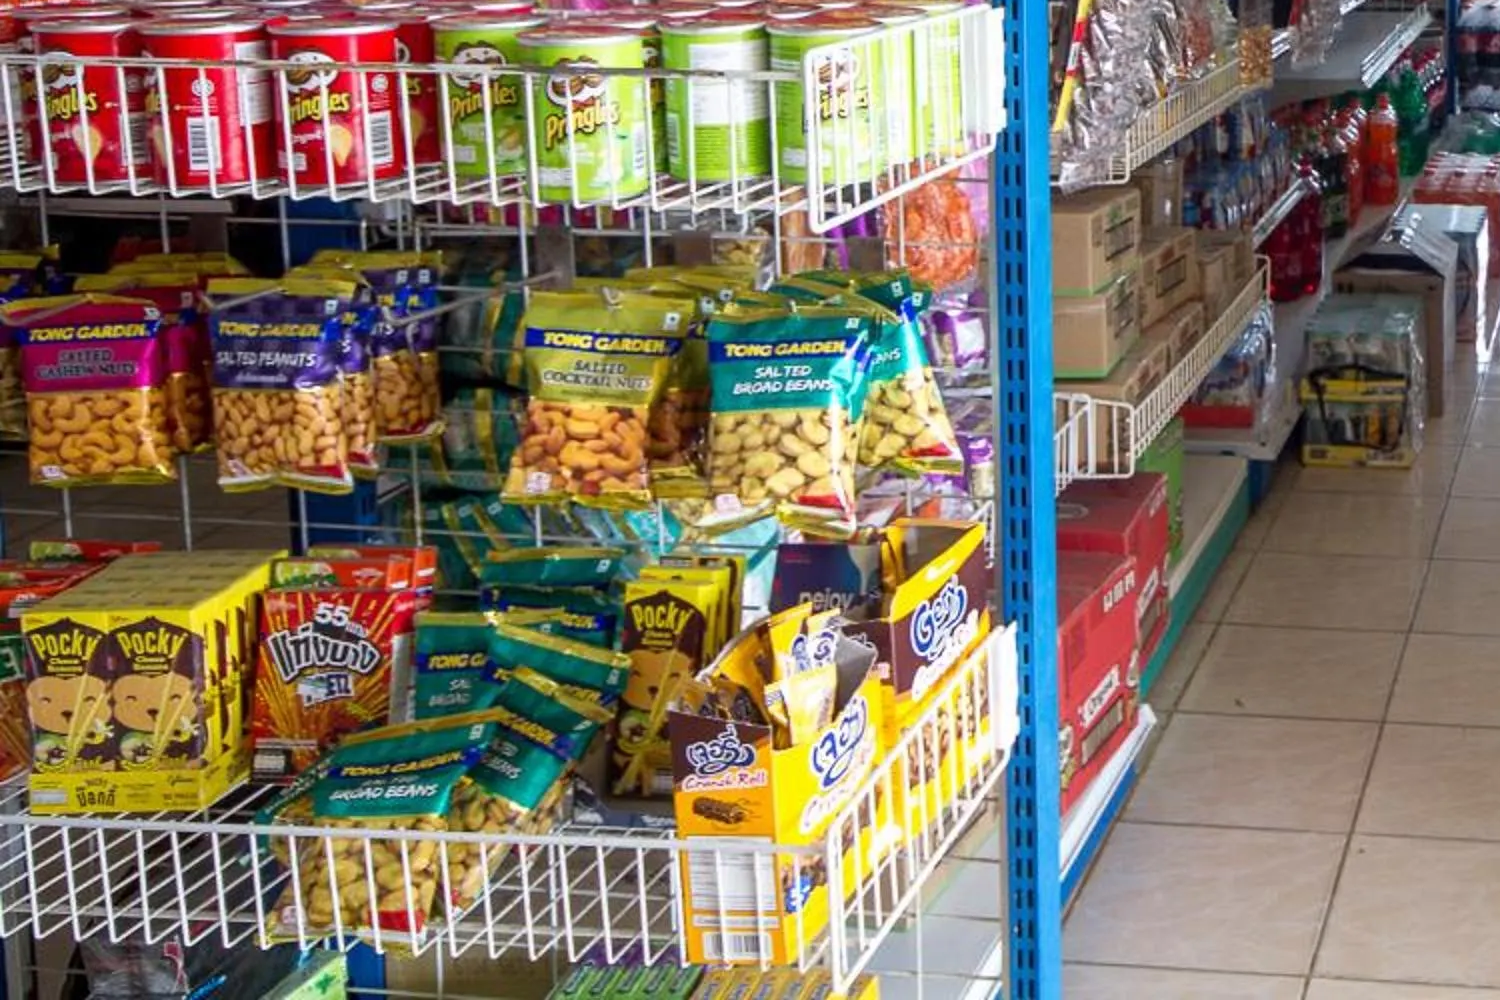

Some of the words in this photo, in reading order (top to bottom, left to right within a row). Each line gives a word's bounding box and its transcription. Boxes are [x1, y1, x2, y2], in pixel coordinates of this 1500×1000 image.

[451, 82, 516, 125] Prinles
[546, 98, 620, 150] Prngls
[29, 327, 75, 342] TONG
[76, 324, 146, 340] GARDEN
[219, 321, 259, 337] TONG
[544, 332, 593, 349] TONG
[595, 337, 666, 353] GARDEN
[724, 343, 773, 357] TONG
[775, 340, 846, 355] GARDEN
[216, 351, 257, 365] SALTED
[258, 351, 317, 368] PEANUTS
[574, 360, 627, 374] SALTED
[543, 370, 612, 387] COCKTAIL
[754, 365, 812, 378] SALTED
[733, 381, 782, 395] BROAD
[784, 379, 835, 393] BEANS
[315, 601, 351, 627] 55
[632, 602, 694, 635] POCKY
[31, 629, 102, 660] POCKY
[117, 627, 188, 658] POCKY
[428, 654, 469, 671] TONG
[391, 752, 464, 773] GARDEN
[684, 774, 732, 790] Crunch
[738, 771, 765, 786] Roll
[385, 784, 438, 799] BEANS
